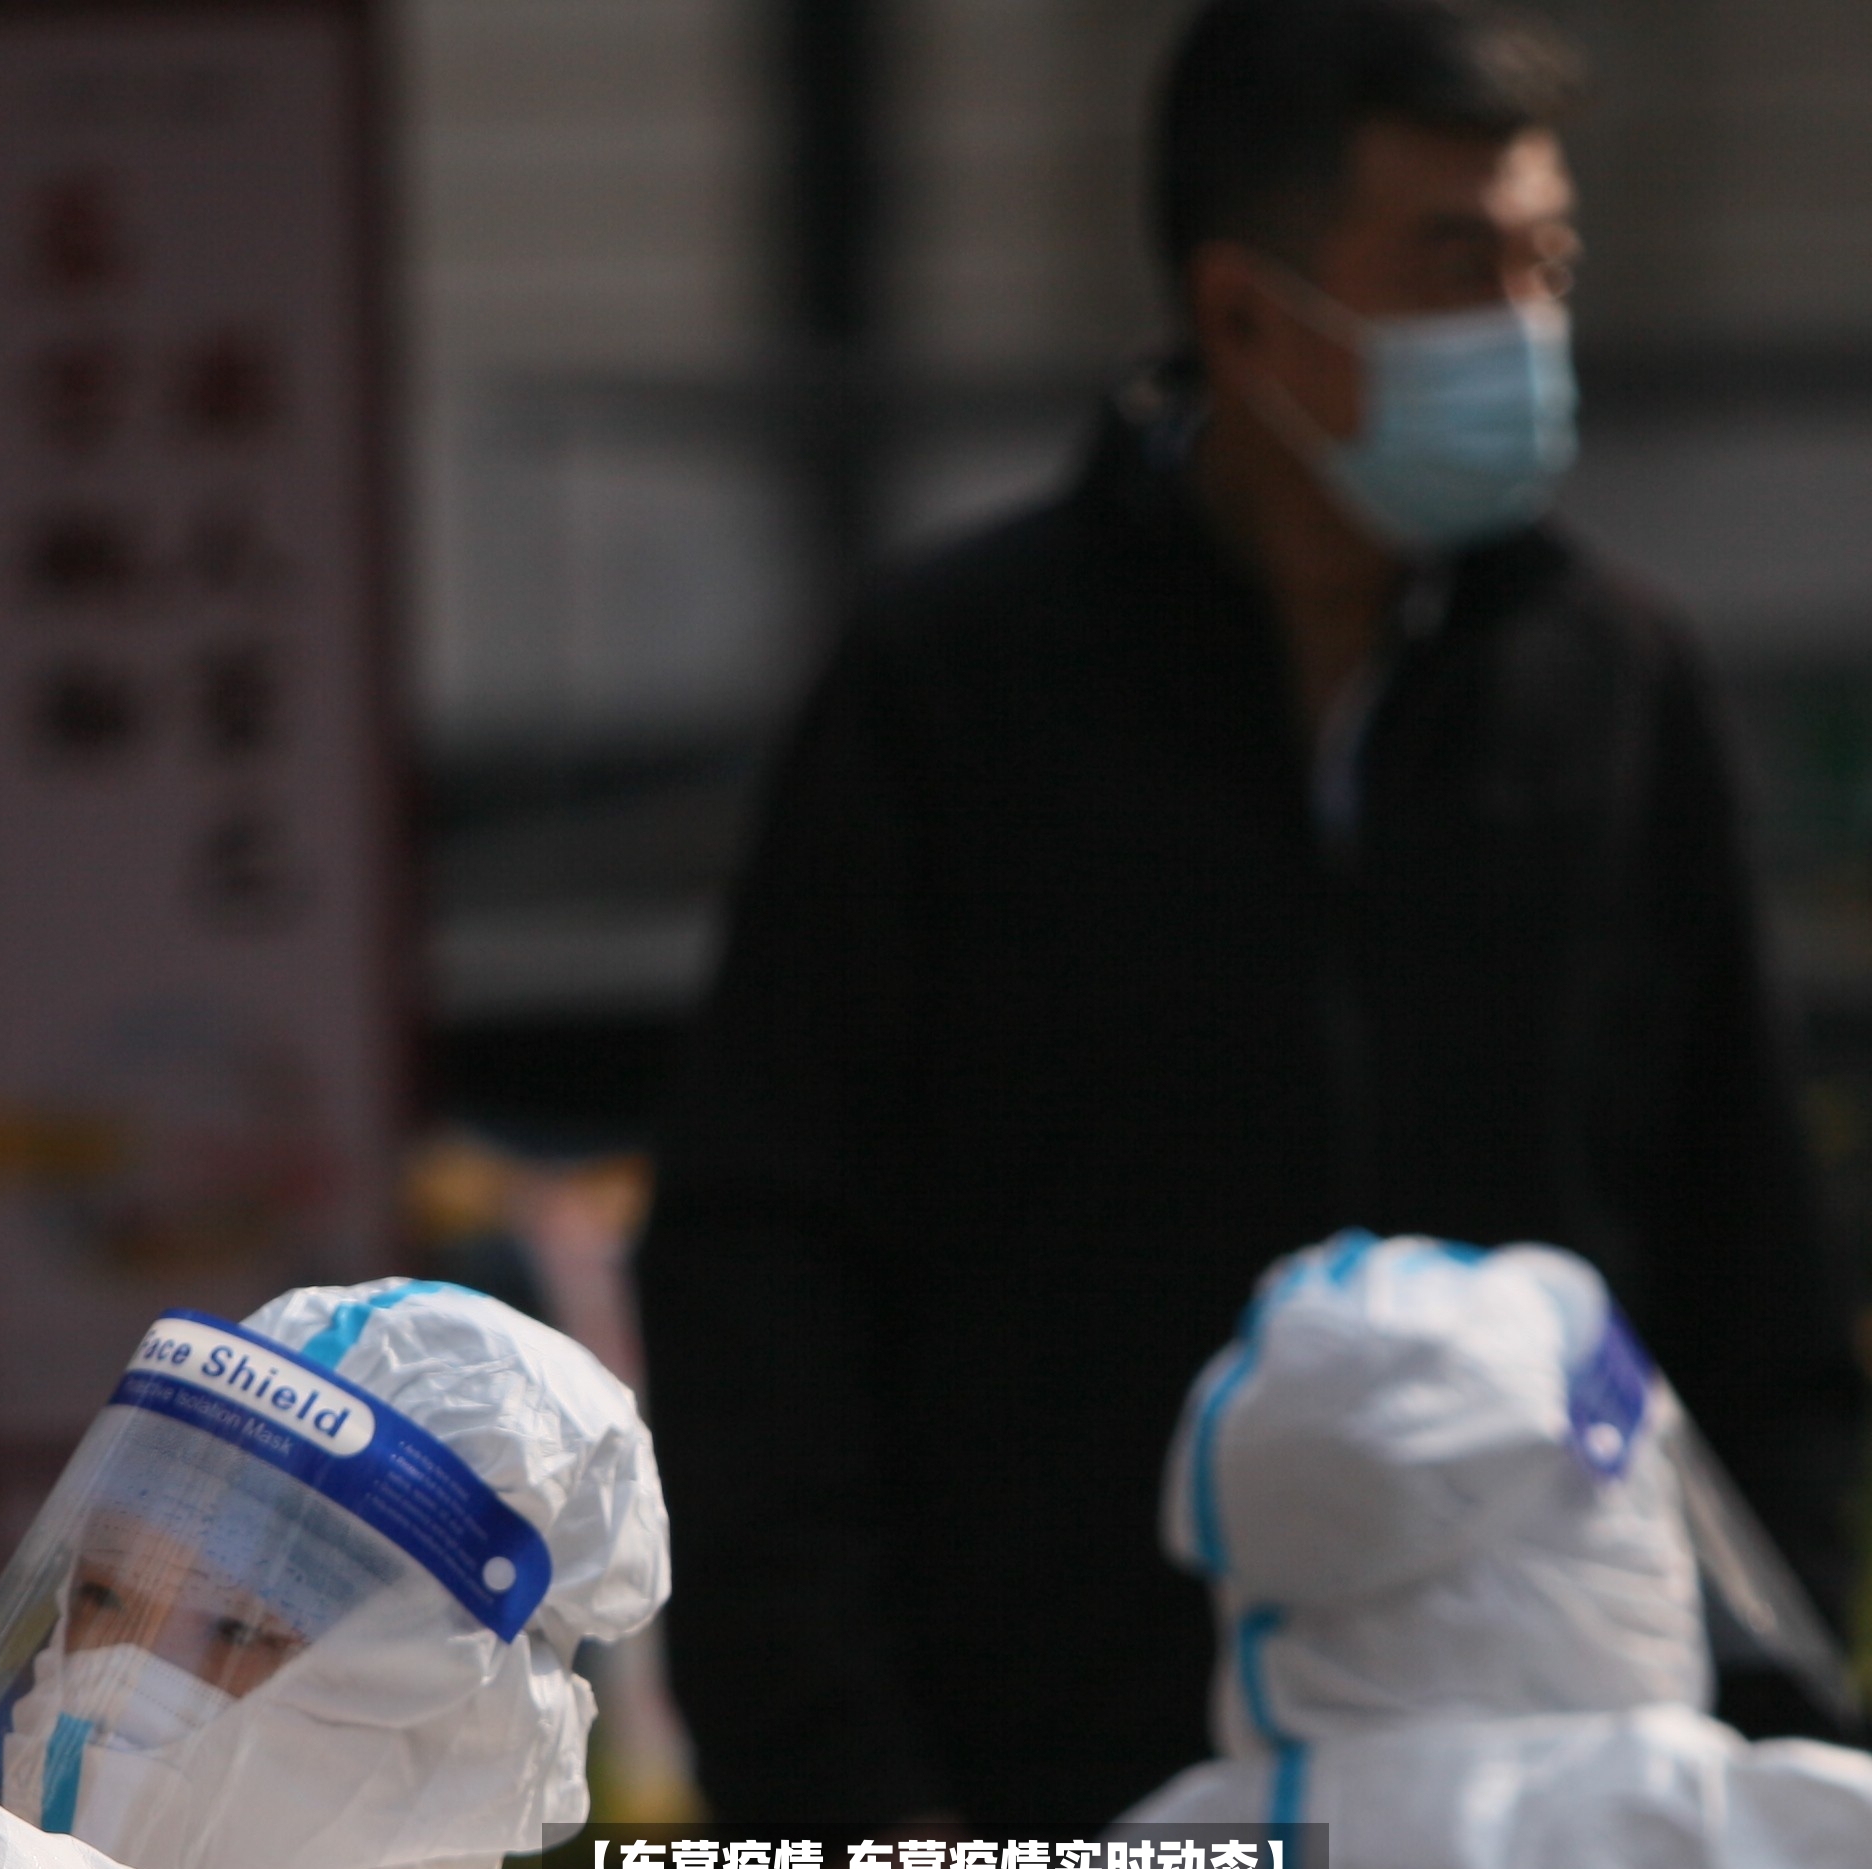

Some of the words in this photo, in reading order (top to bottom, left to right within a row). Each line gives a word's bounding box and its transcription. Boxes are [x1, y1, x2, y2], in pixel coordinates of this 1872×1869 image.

[176, 1388, 242, 1428] Isolation
[242, 1417, 294, 1456] Mask
[200, 1344, 352, 1438] Shield
